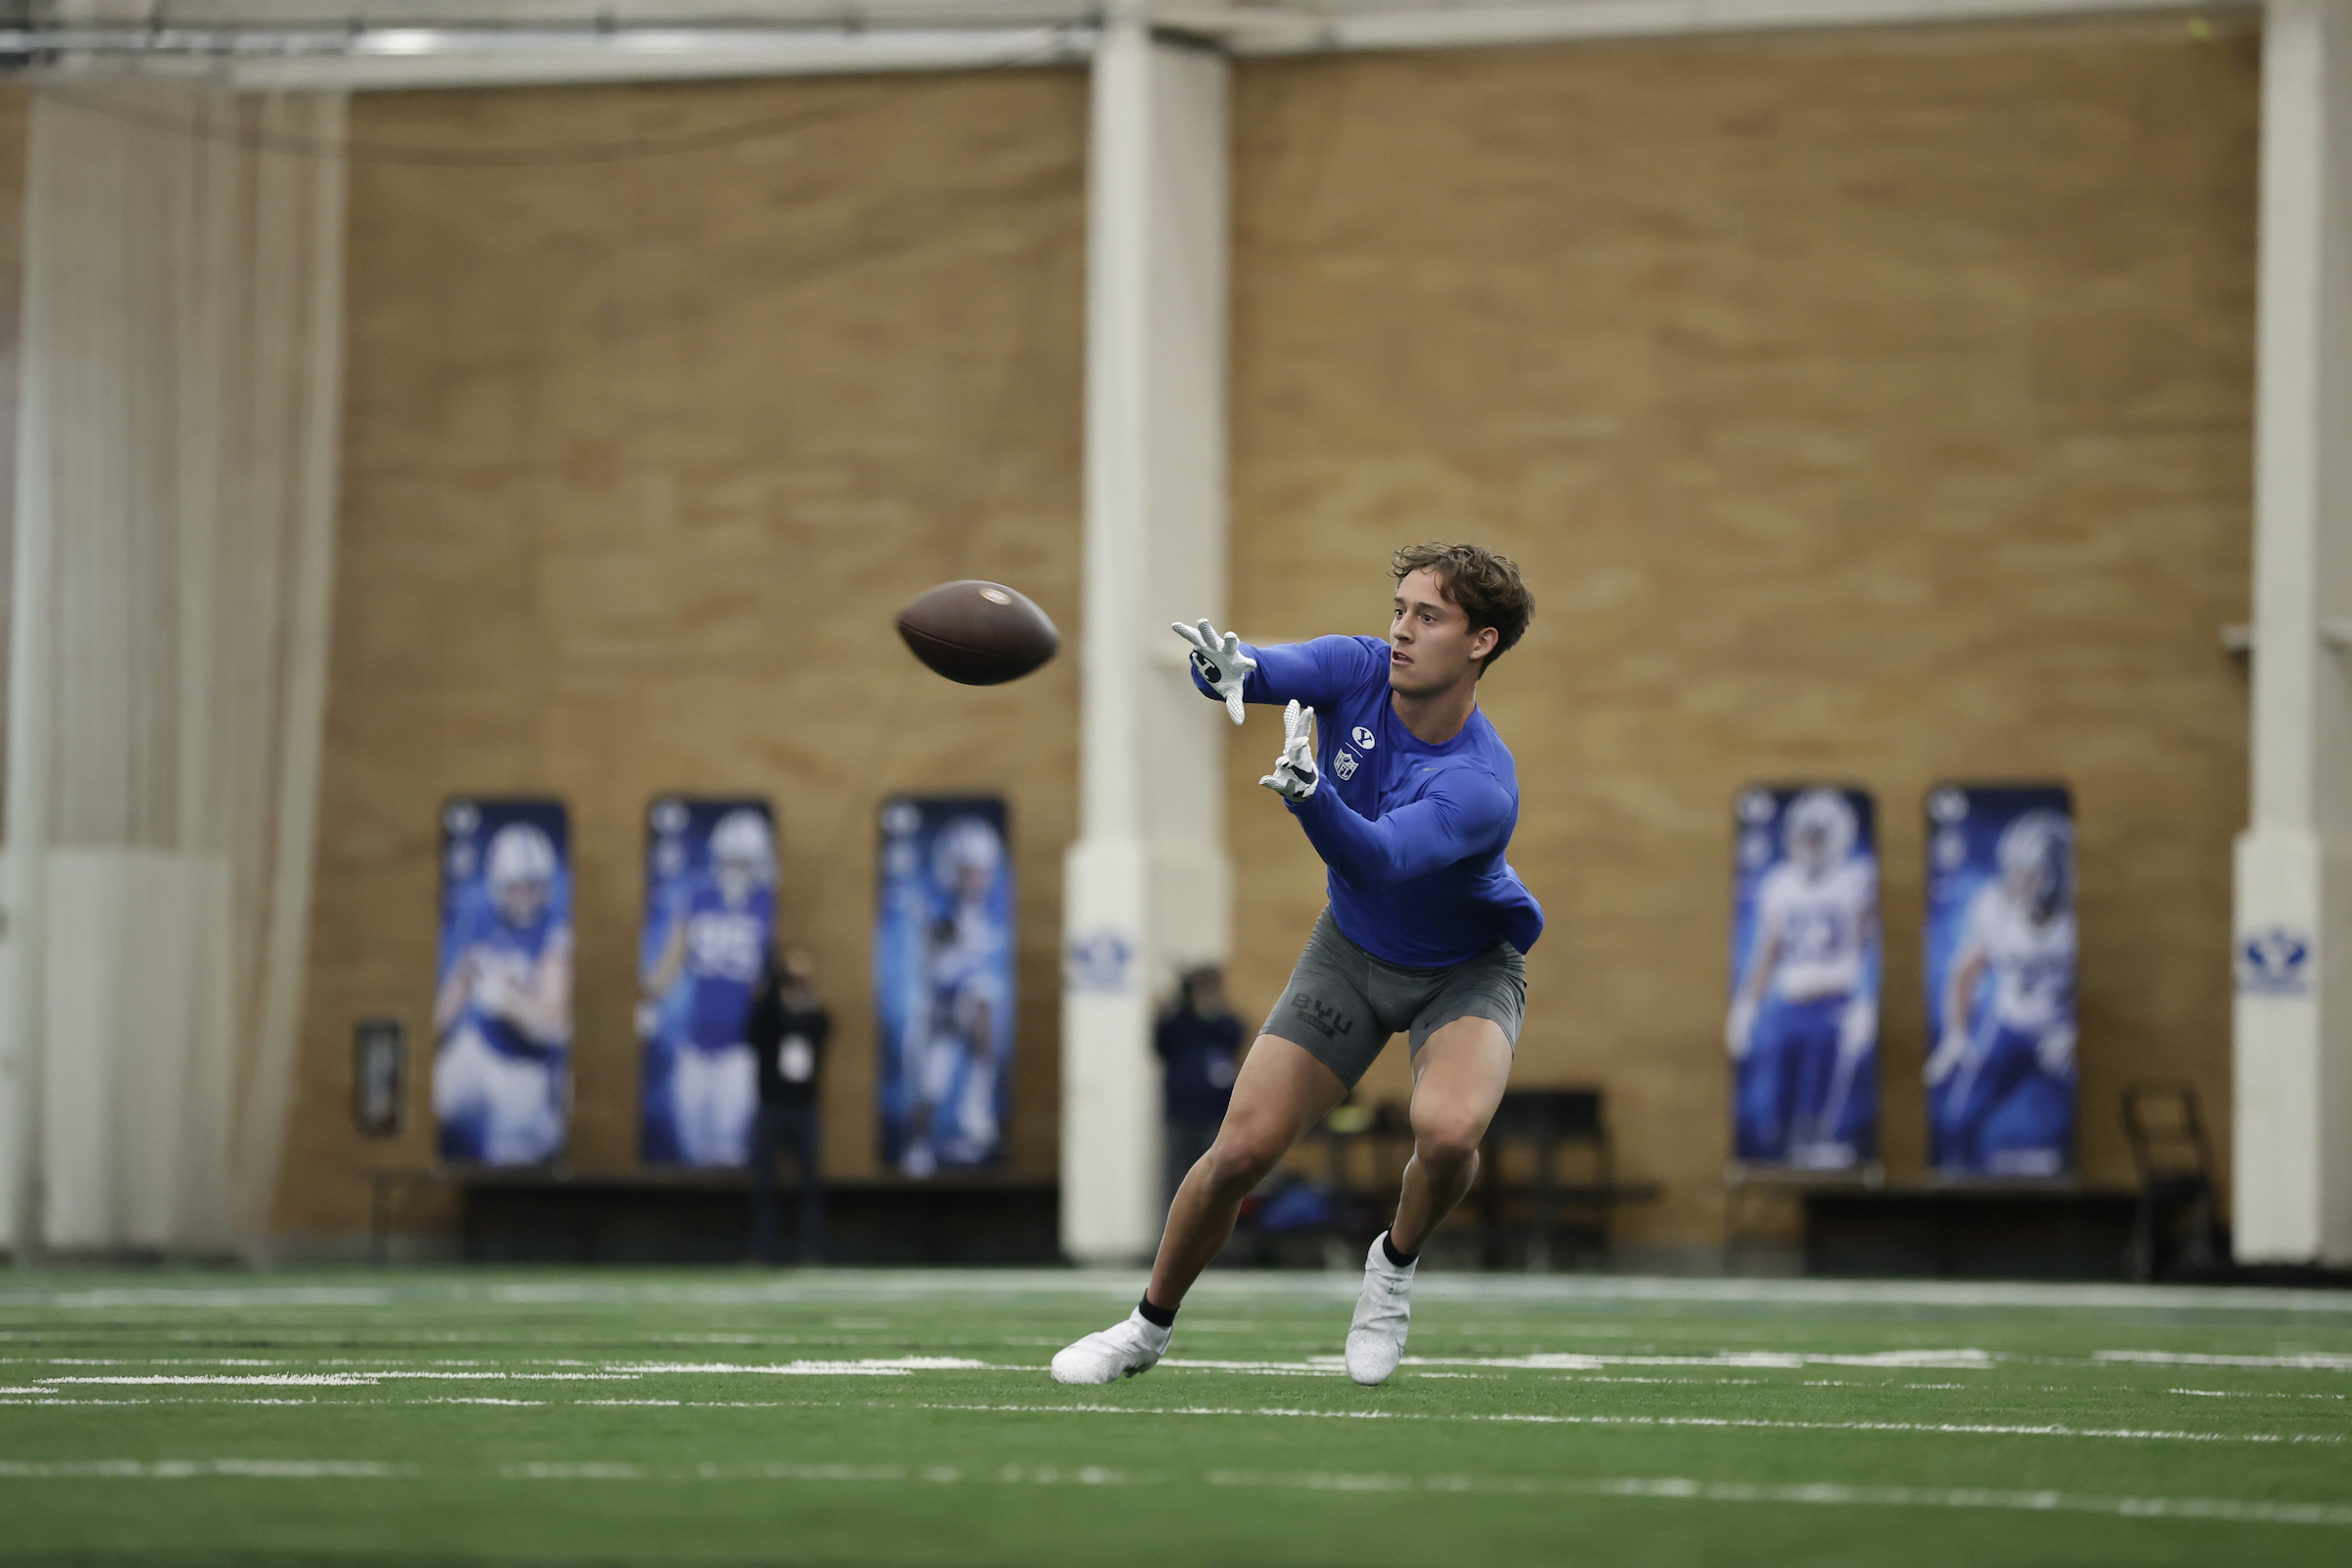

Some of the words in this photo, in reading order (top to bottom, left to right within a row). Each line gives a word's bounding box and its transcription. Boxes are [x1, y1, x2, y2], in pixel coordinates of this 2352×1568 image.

[1357, 728, 1373, 746] Y
[1335, 756, 1353, 779] NFL
[1291, 992, 1353, 1035] BYU
